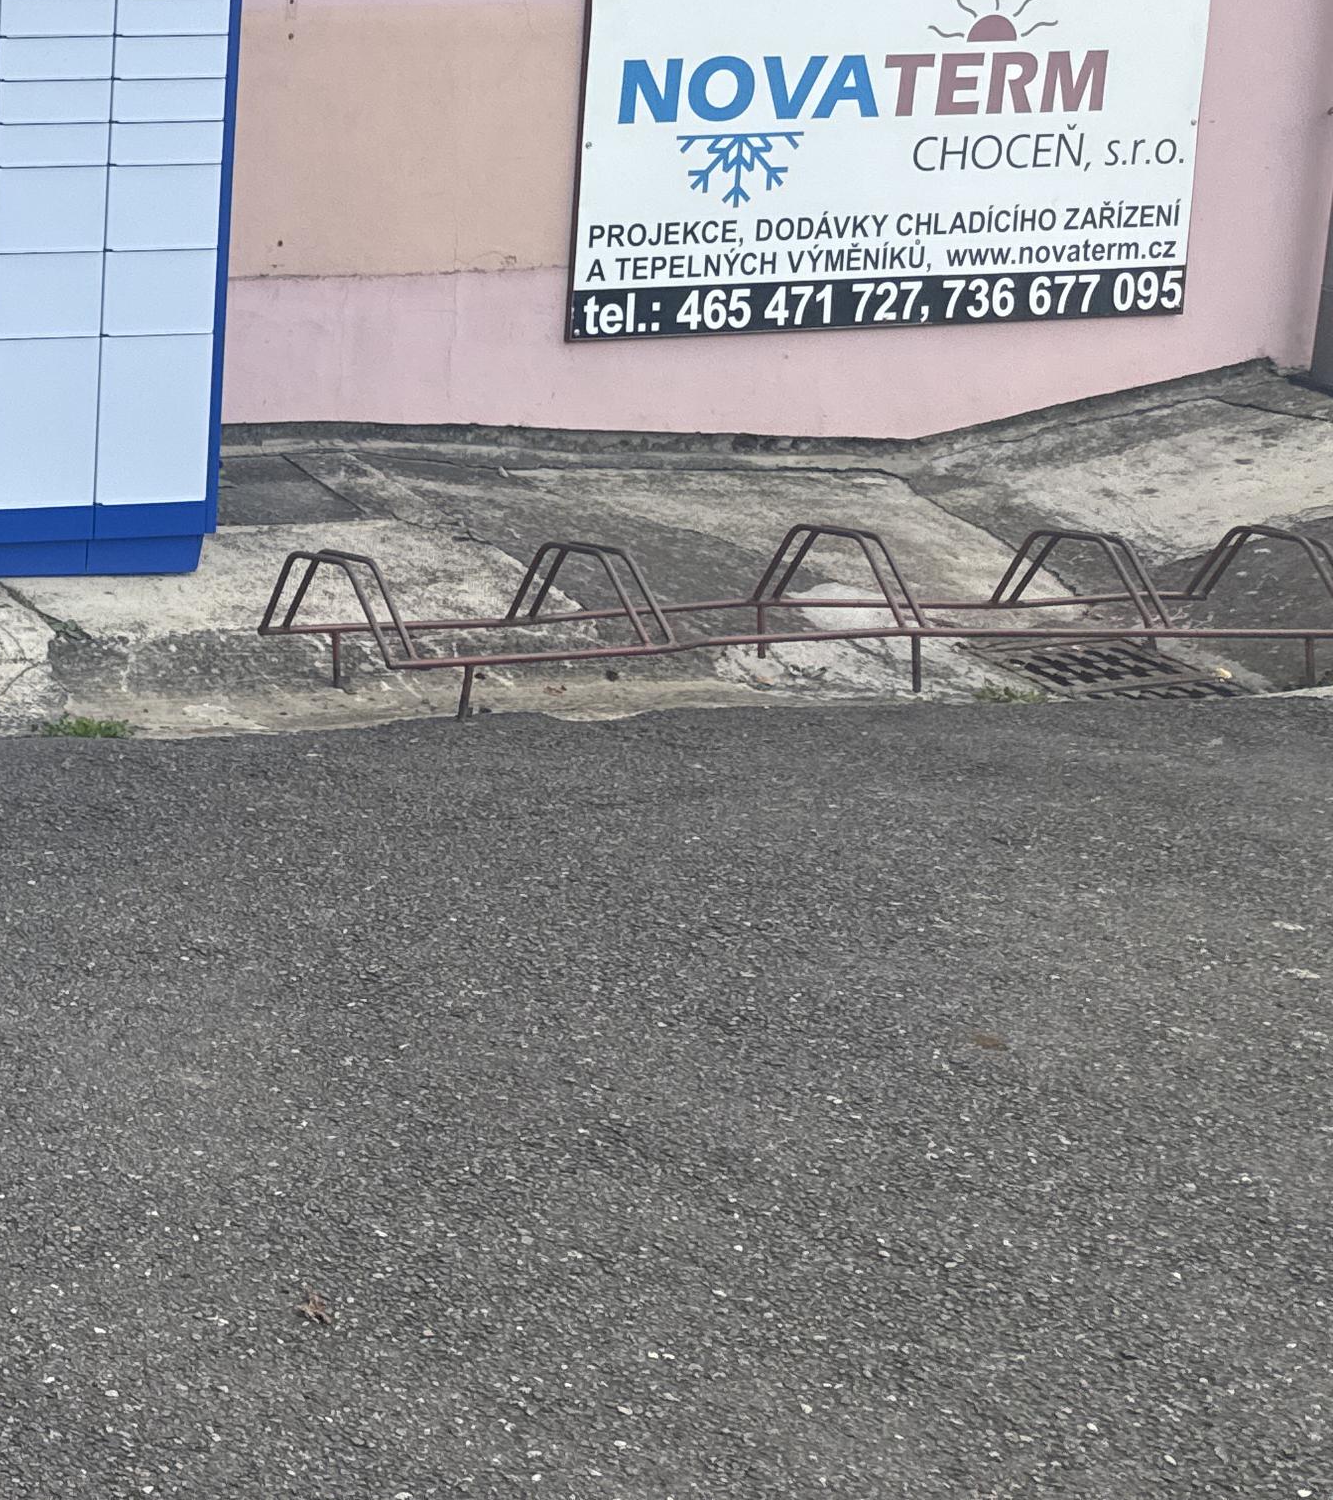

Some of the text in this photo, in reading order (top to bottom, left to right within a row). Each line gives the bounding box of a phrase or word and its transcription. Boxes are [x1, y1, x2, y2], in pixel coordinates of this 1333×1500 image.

[617, 48, 1109, 125] NOVATERM
[911, 124, 1186, 172] CHOCEŇ, s.r.o.
[588, 199, 1182, 249] PROJEKCE, DODÁVKY CHLADÍCÍHO ZAŘÍZENÍ
[586, 238, 1177, 282] A TEPELNÝCH VÝMĚNÍKŮ, www.novaterm.cz
[583, 269, 1183, 335] tel.: 465 471 727, 736 677 095
